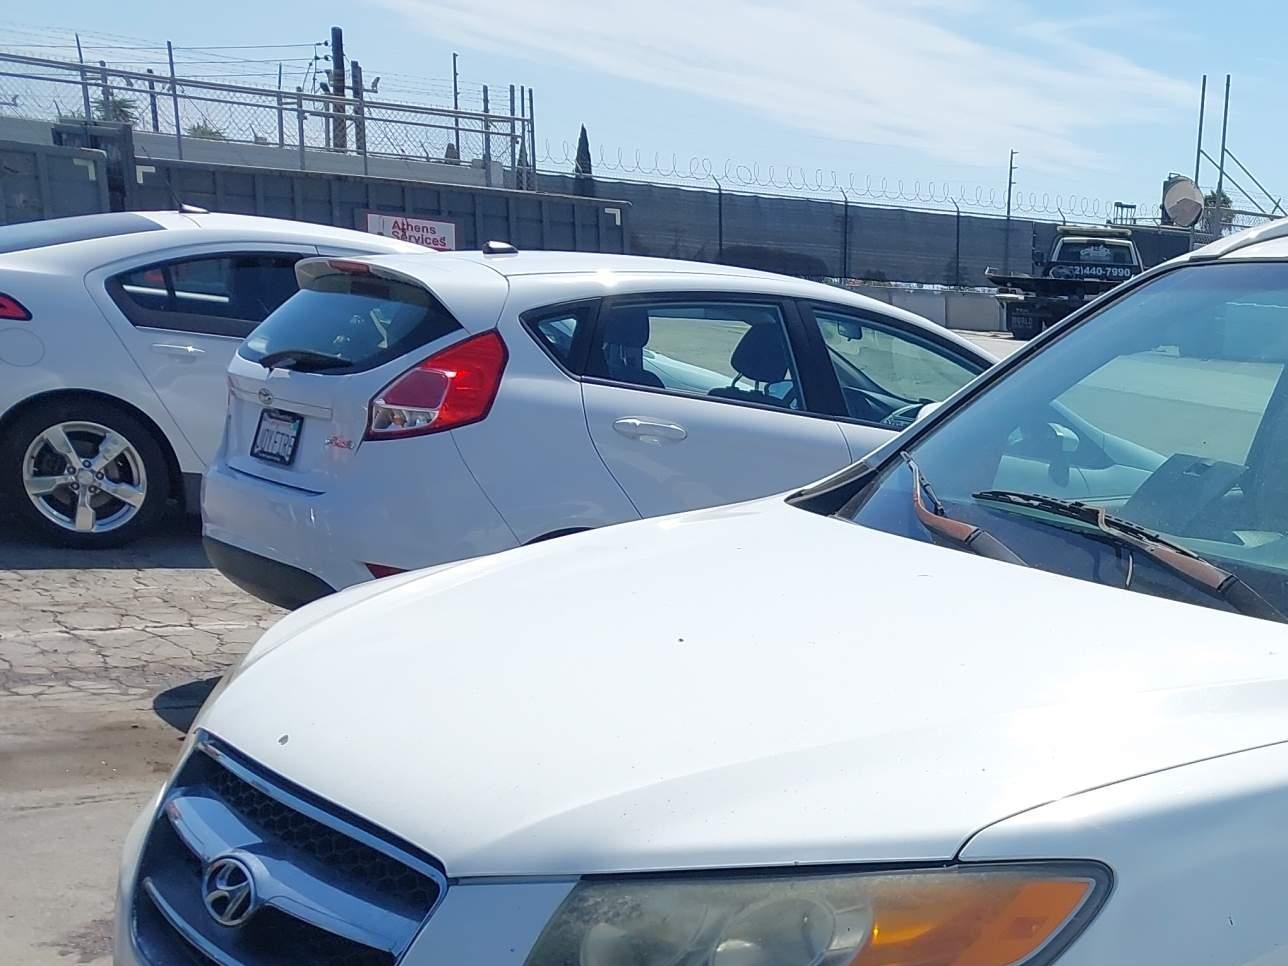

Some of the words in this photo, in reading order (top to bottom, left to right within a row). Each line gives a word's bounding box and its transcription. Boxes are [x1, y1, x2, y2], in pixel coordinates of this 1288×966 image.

[391, 218, 437, 235] Athens
[391, 230, 447, 247] Services
[1070, 265, 1130, 277] 2)440-7990
